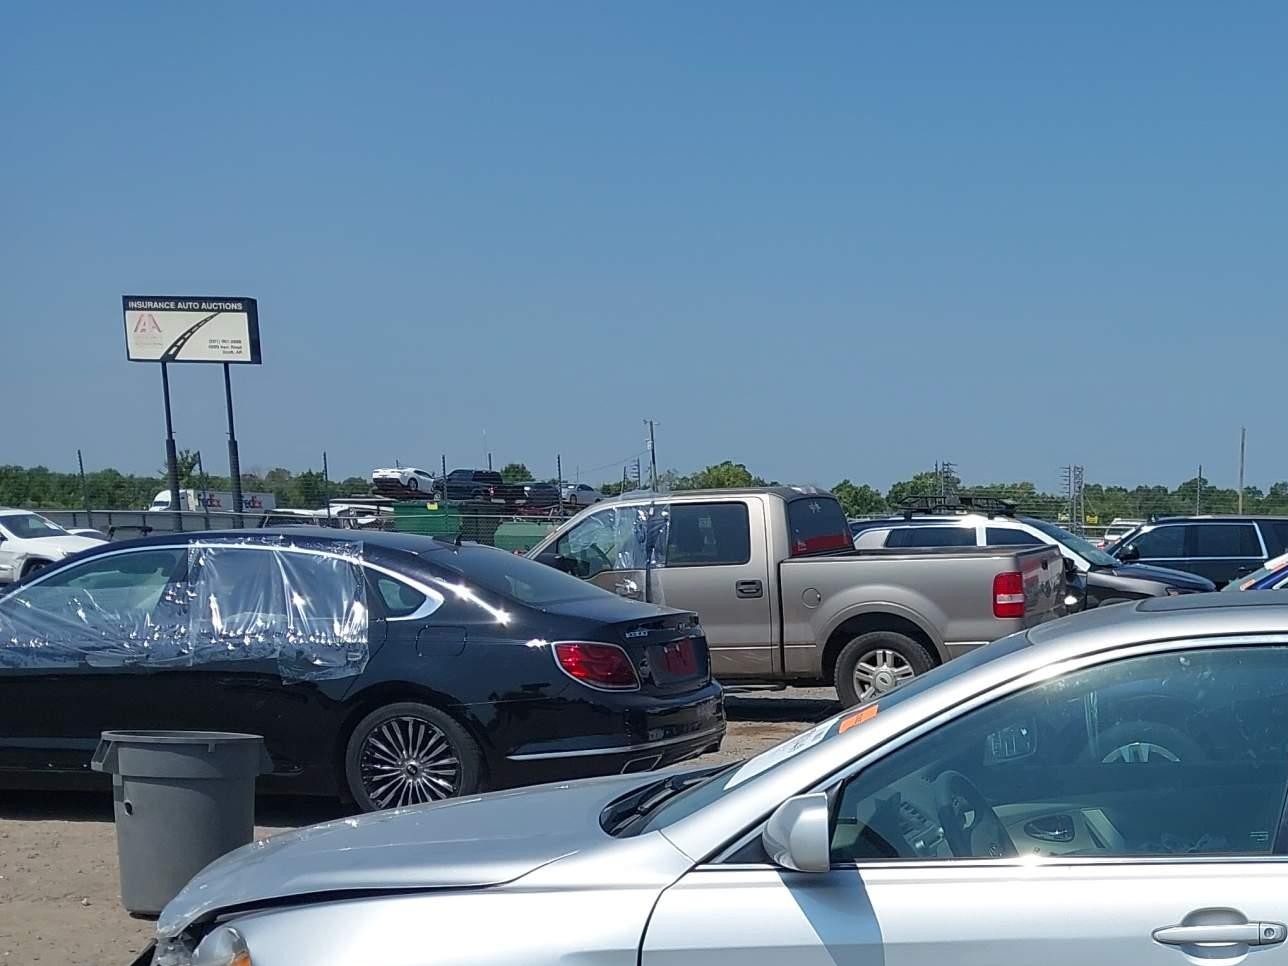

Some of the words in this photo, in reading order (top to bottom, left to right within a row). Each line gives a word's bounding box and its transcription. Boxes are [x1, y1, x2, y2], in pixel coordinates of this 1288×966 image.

[128, 300, 176, 309] INSURANCE
[177, 301, 200, 310] AUTO
[201, 301, 243, 310] AUCTIONS
